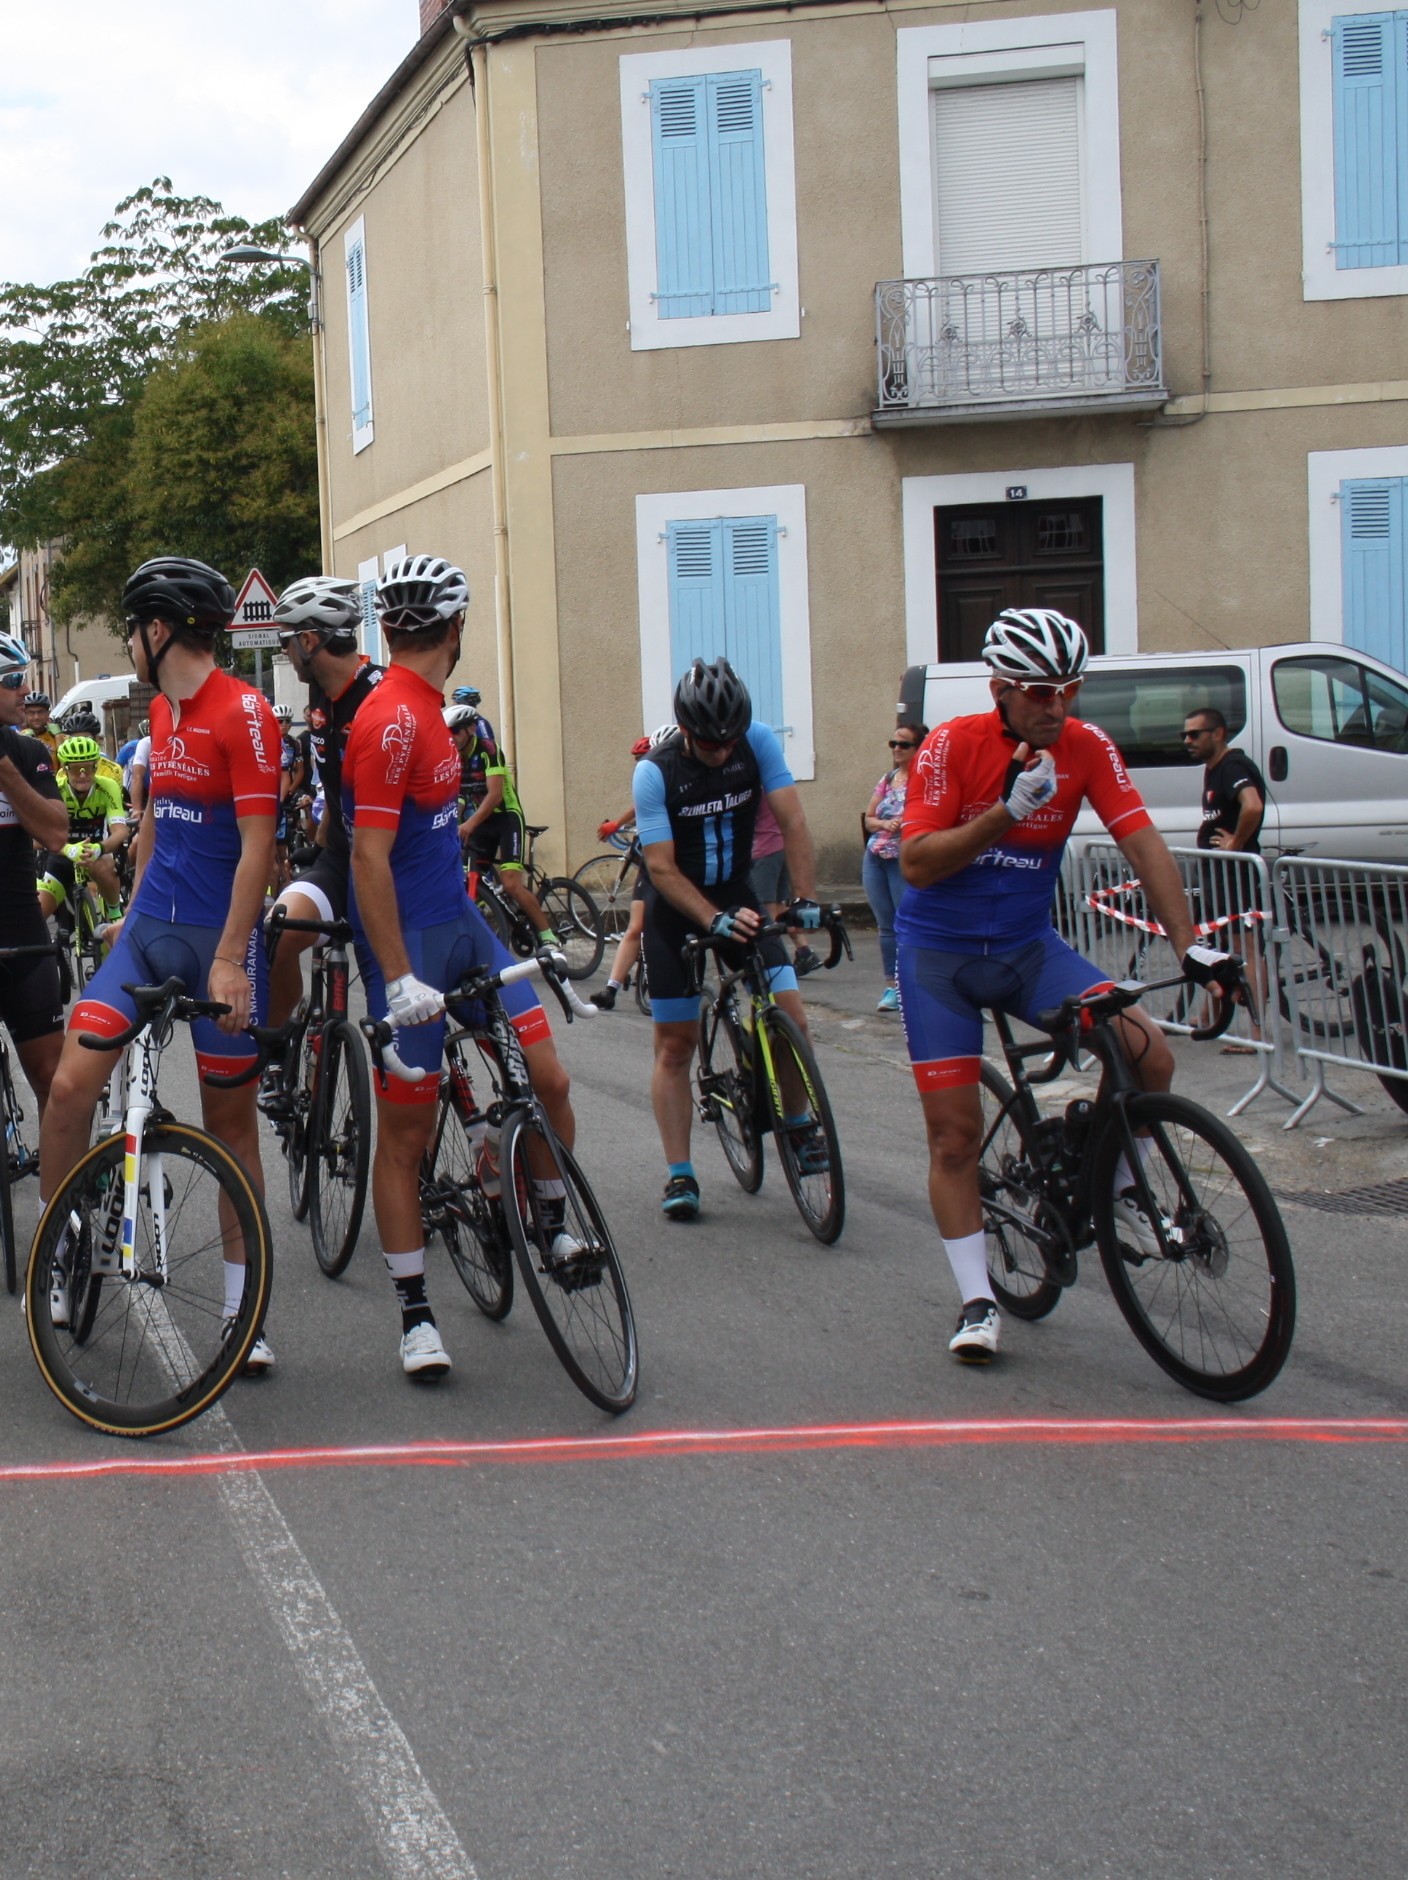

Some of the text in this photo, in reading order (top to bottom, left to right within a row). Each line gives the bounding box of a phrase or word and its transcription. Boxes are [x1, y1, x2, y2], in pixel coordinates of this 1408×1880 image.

[1010, 489, 1023, 498] 14
[241, 694, 267, 764] Barteau
[1082, 722, 1127, 784] Barteau
[932, 789, 940, 806] LES
[247, 928, 258, 1016] MADIRANAIS
[333, 970, 345, 1011] BMC
[154, 1213, 163, 1270] LOOK
